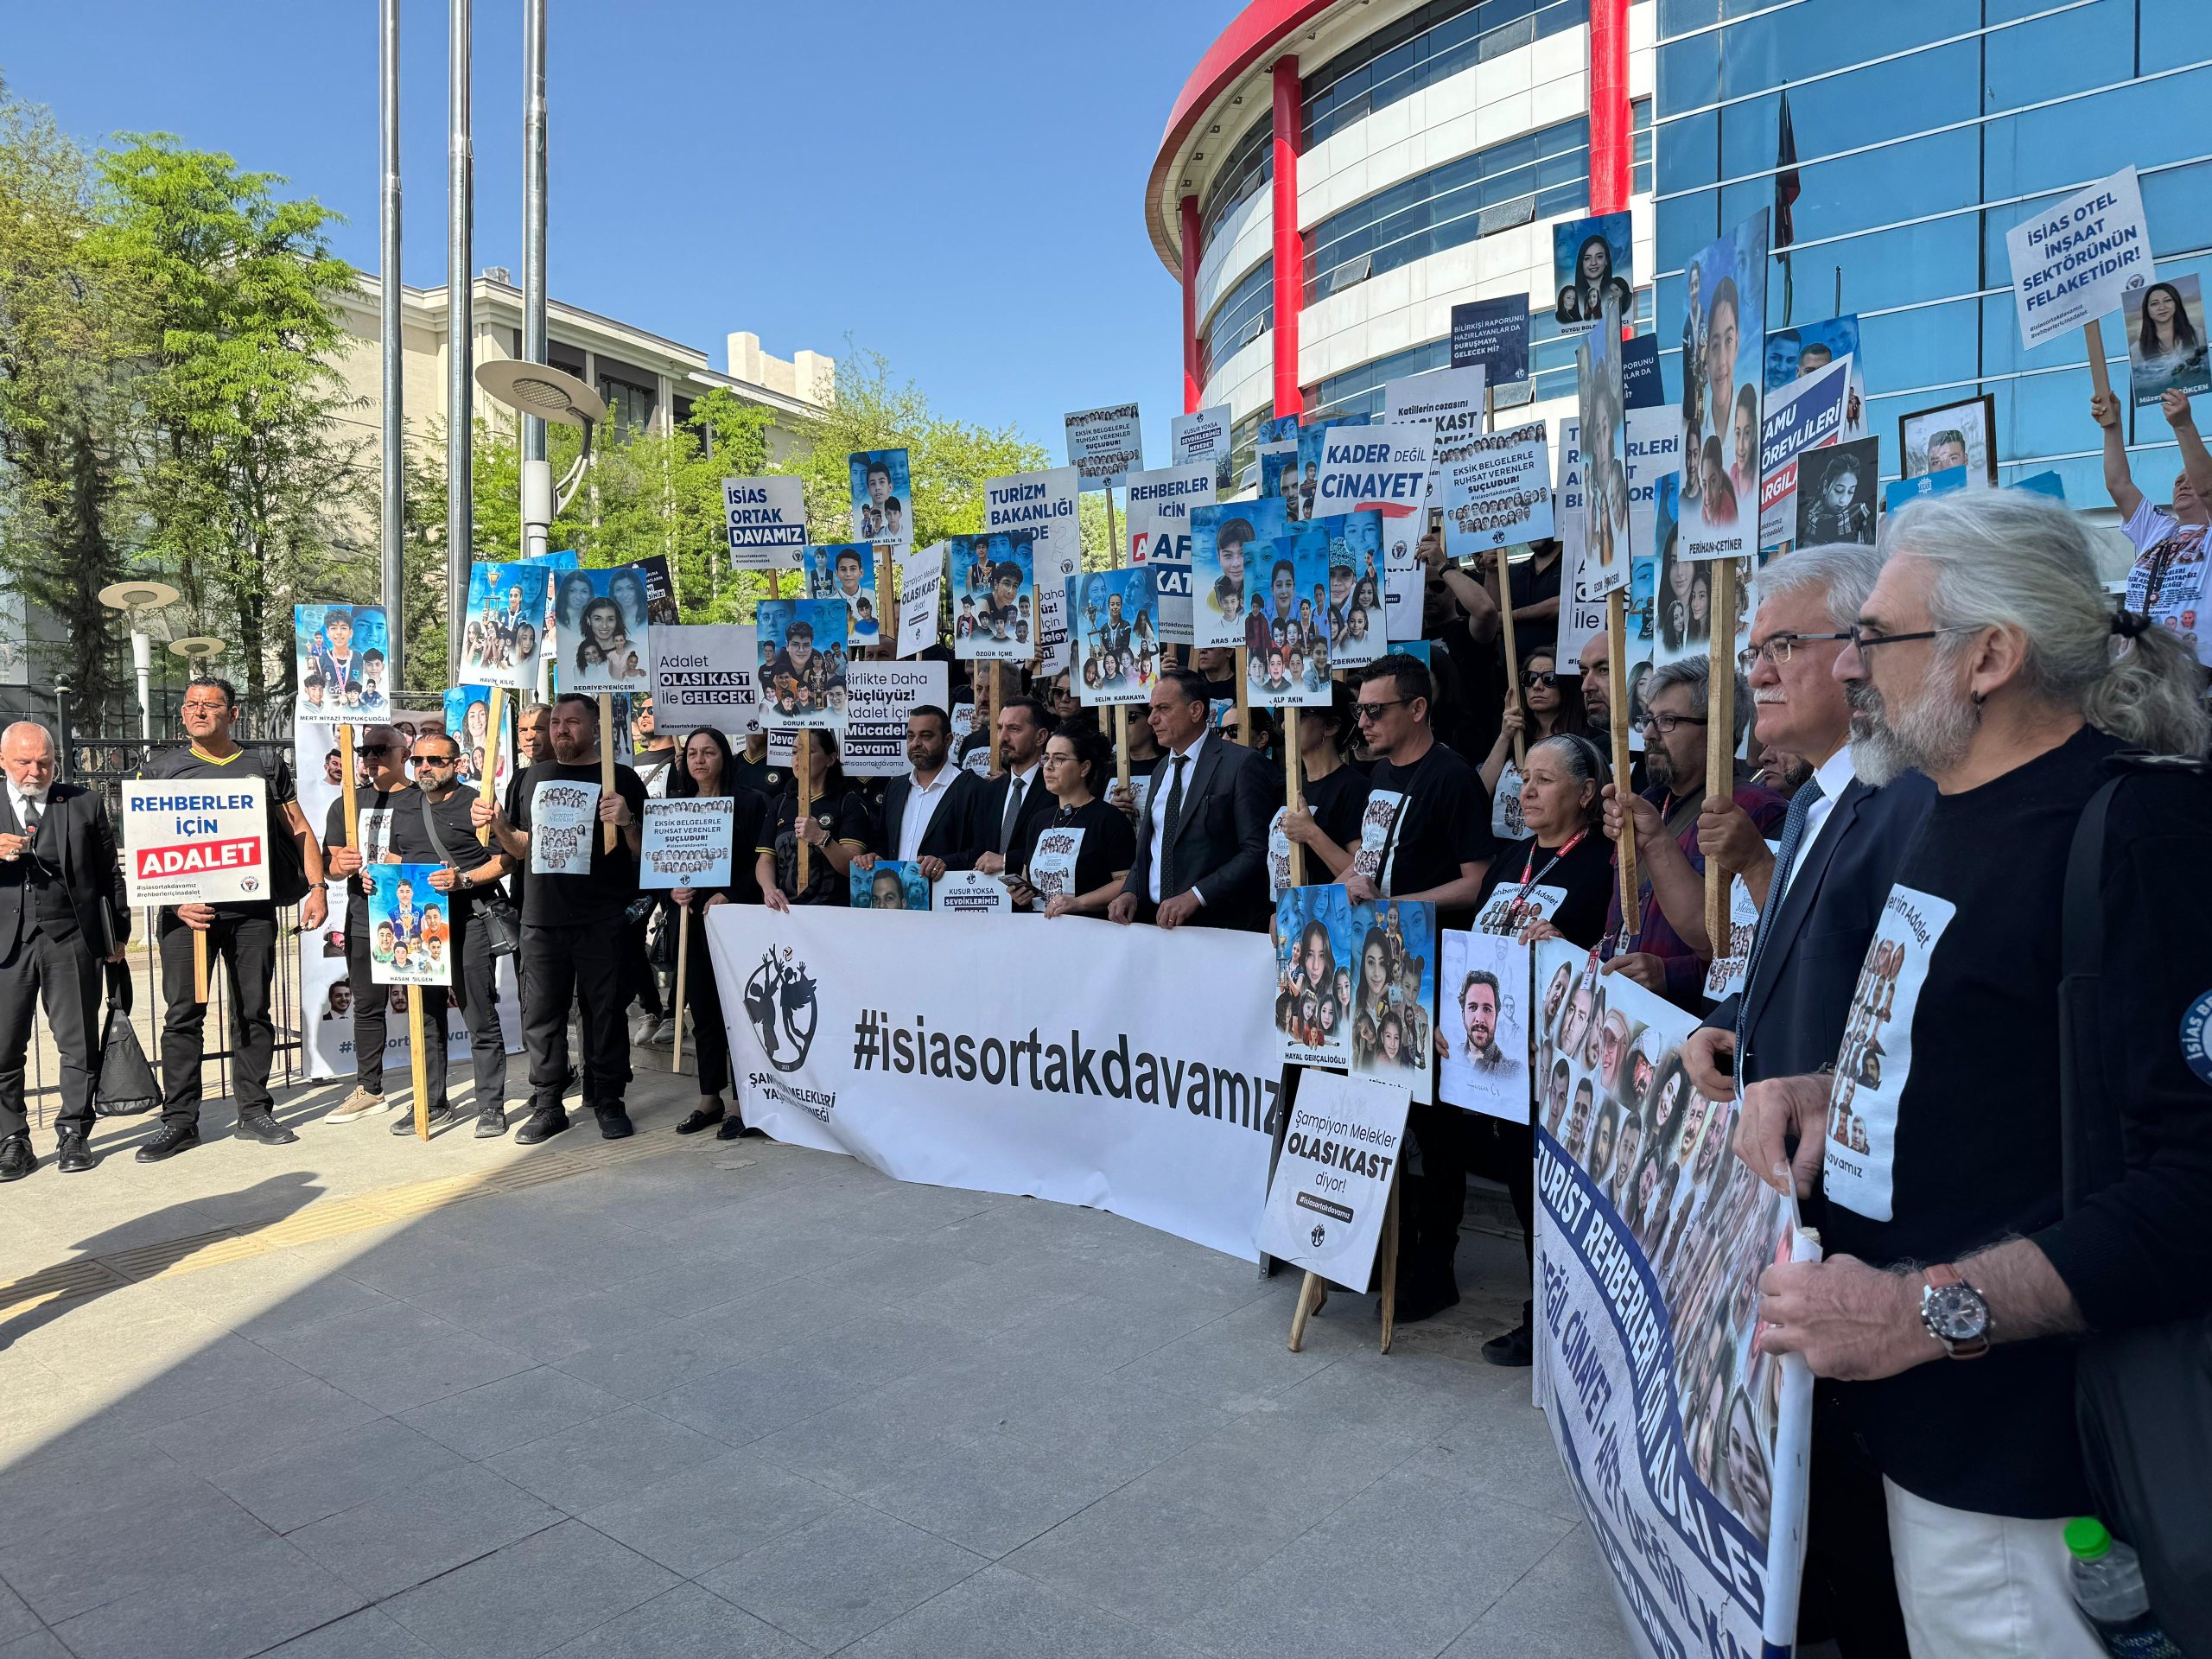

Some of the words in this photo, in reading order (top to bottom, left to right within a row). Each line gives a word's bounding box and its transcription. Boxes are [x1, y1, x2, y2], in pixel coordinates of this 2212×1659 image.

[2028, 214, 2069, 247] İSİAS
[2074, 192, 2117, 222] OTEL
[2044, 218, 2105, 259] İNŞAAT
[2023, 225, 2138, 292] SEKTÖRÜNÜN
[2026, 246, 2140, 311] FELAKETİDİR!
[1454, 320, 1484, 333] BİLİRKİŞİ
[1484, 315, 1525, 328] RAPORUNU
[1454, 326, 1510, 341] HAZIRLAYANLAR
[1454, 338, 1497, 351] DURUŞMAYA
[1454, 347, 1487, 359] GELECEK
[1435, 411, 1478, 432] KAST
[1326, 443, 1390, 464] KADER
[1394, 447, 1427, 462] DEĞİL
[1453, 463, 1478, 476] EKSİK
[1478, 450, 1534, 471] BELGELERLE
[1453, 474, 1487, 486] RUHSAT
[1488, 461, 1535, 479] VERENLER
[989, 483, 1046, 505] TURİZM
[1131, 476, 1209, 501] REHBERLER
[1321, 472, 1424, 499] CİNAYET
[1467, 476, 1520, 493] SUÇLUDUR!
[728, 486, 766, 505] İSİAS
[731, 507, 783, 524] ORTAK
[990, 498, 1073, 525] BAKANLIĞI
[733, 527, 803, 545] DAVAMIZ
[902, 586, 922, 605] OLASI
[921, 577, 940, 598] KAST
[660, 655, 709, 668] Adalet
[660, 673, 705, 686] OLASI
[708, 672, 749, 685] KAST
[848, 672, 887, 684] Birlikte
[892, 673, 928, 684] Daha
[662, 690, 678, 704] İle
[682, 690, 754, 704] GELECEK!
[848, 689, 915, 707] Güçlüyüz!
[848, 707, 889, 718] Adalet
[845, 741, 900, 754] Devam!
[131, 794, 254, 812] REHBERLER
[175, 817, 218, 836] İÇİN
[654, 818, 675, 827] EKSİK
[664, 835, 708, 843] SUÇLUDUR!
[141, 842, 255, 876] ADALET
[945, 896, 998, 906] SEVDİKLERİMİZ
[1904, 905, 1931, 950] Adalet
[1285, 1052, 1303, 1061] HAYAL
[853, 1007, 1281, 1137] #isiasortakdavamız
[790, 1086, 836, 1109] MELEKLERİ
[1296, 1109, 1348, 1137] Şampiyon
[1350, 1126, 1397, 1149] Melekler
[1287, 1132, 1339, 1167] OLASI
[1339, 1145, 1394, 1182] KAST
[1315, 1171, 1346, 1193] diyor!
[1538, 1139, 1592, 1236] TURİST
[1581, 1207, 1667, 1389] REHBERLERİ
